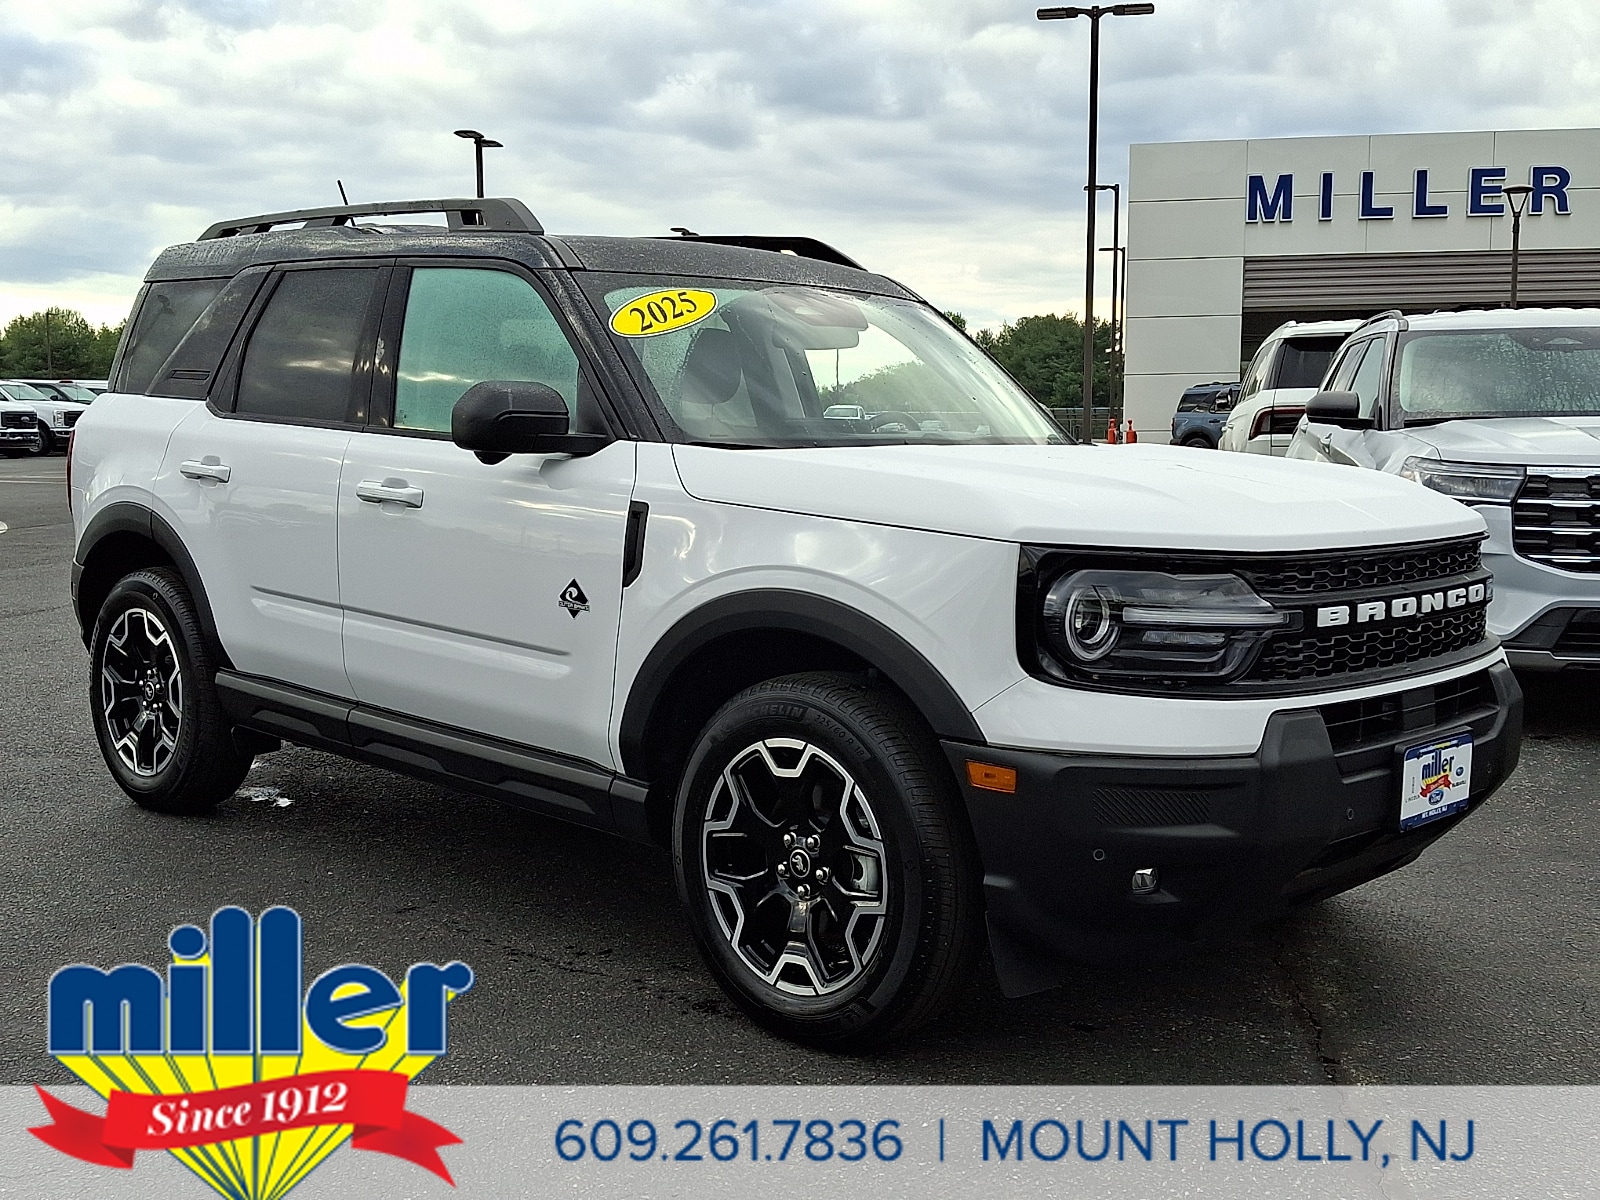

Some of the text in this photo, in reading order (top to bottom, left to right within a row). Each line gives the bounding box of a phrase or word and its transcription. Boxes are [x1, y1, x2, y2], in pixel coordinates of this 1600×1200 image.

[1245, 165, 1572, 223] MILLER
[629, 291, 698, 333] 2025
[1316, 583, 1485, 628] BRONCO
[1422, 749, 1455, 780] miller
